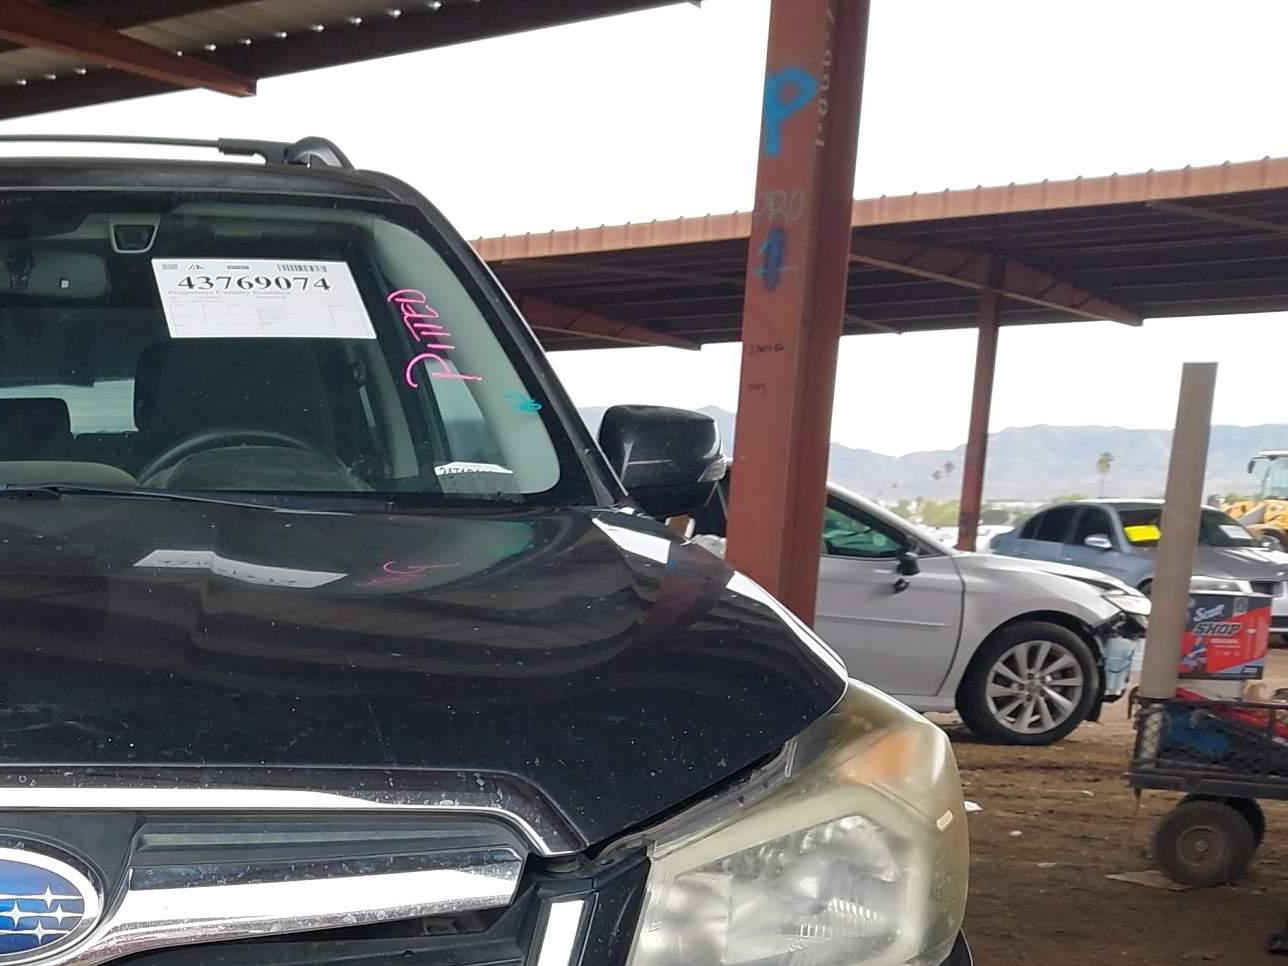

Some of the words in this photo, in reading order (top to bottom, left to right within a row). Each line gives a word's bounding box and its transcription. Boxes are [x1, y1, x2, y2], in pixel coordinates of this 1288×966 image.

[765, 66, 818, 158] P
[178, 275, 330, 291] 43769074
[1194, 622, 1242, 636] SHOP
